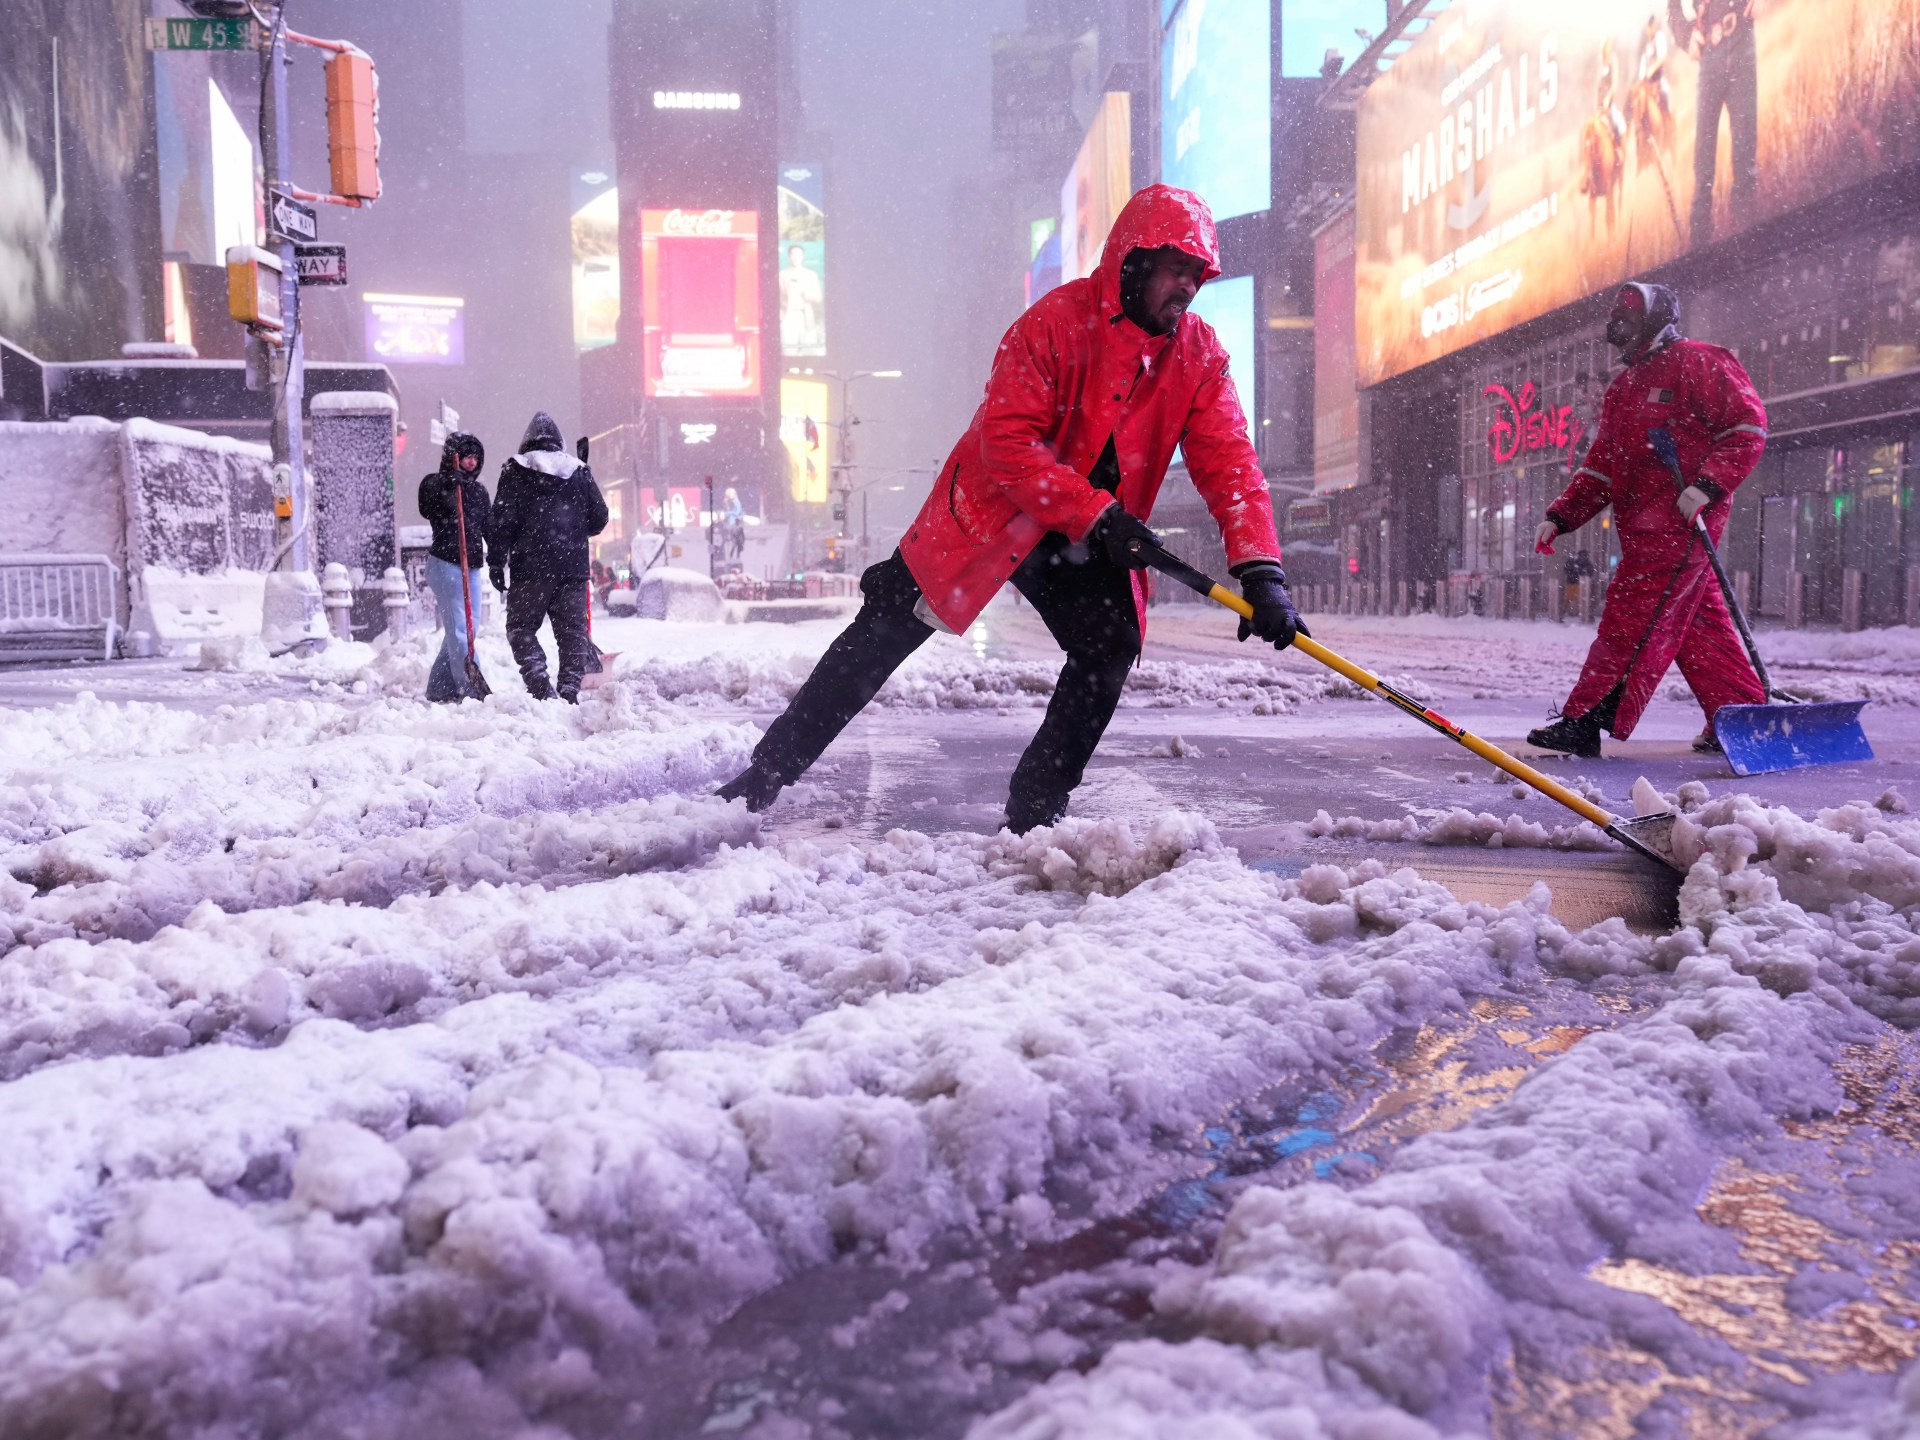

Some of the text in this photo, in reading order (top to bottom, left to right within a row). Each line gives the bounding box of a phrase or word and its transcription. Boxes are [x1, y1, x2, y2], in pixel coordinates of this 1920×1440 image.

[172, 23, 190, 47] W
[202, 23, 227, 48] 45
[653, 91, 740, 110] SAMSUNG
[1402, 31, 1558, 213] MARSHALS
